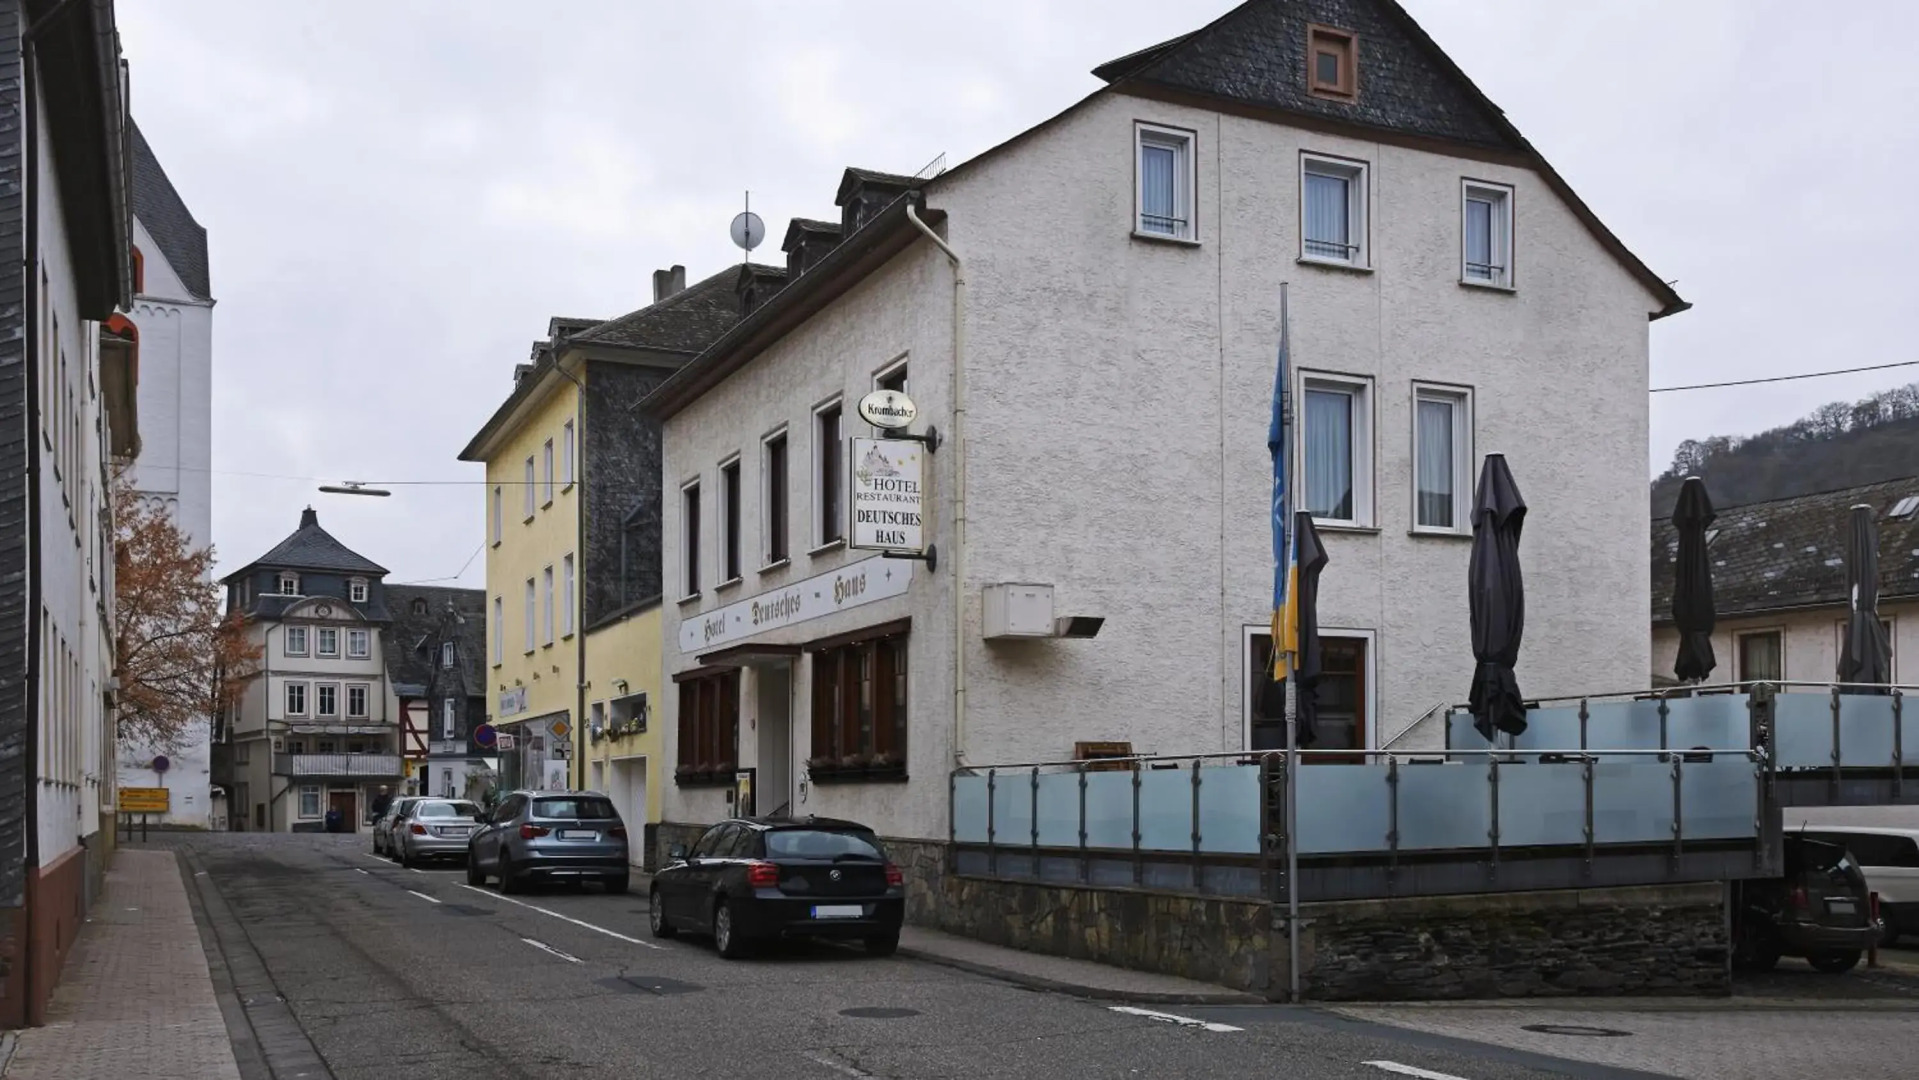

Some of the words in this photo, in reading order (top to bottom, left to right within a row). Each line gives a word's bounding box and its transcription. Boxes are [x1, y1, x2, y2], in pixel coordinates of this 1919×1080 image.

[867, 403, 914, 418] Krombacher
[874, 478, 921, 493] HOTEL
[856, 492, 922, 504] RESTAURANT
[857, 509, 922, 527] DEUTSCHES
[875, 530, 906, 545] HAUS
[704, 613, 725, 642] Hotel
[752, 592, 801, 626] Deutsches
[834, 574, 866, 605] Haus
